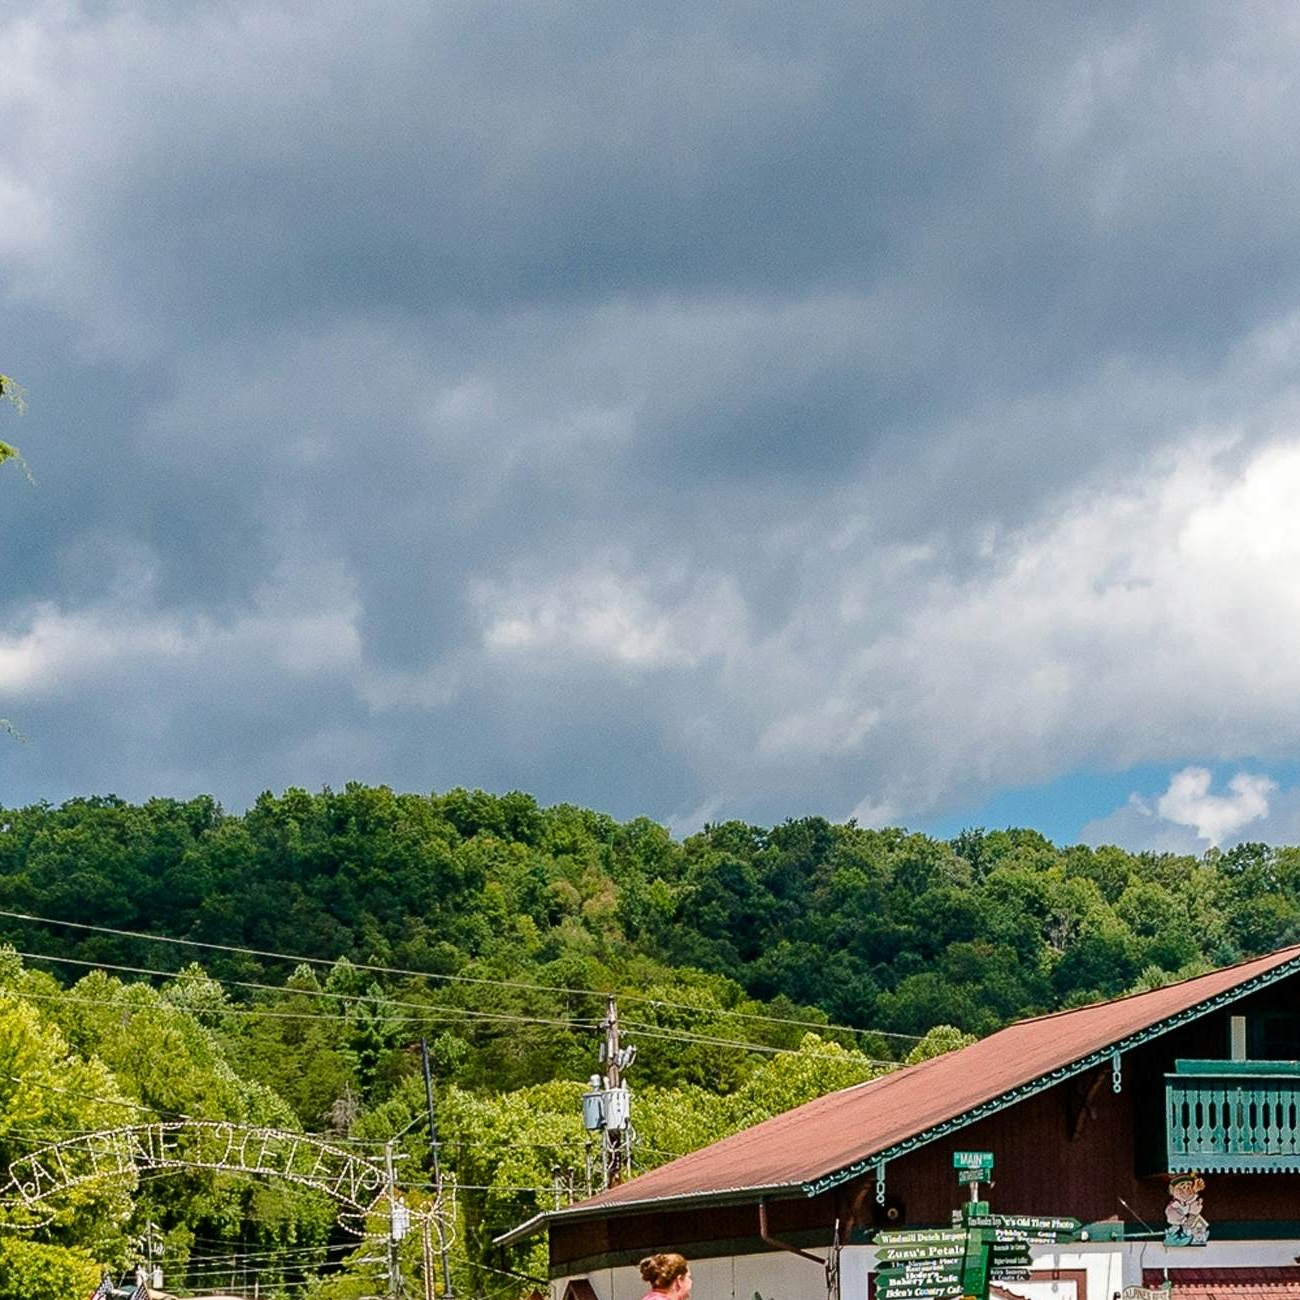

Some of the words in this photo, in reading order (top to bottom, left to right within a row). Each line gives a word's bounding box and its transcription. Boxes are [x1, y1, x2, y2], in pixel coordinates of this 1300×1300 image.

[960, 1152, 982, 1165] MAIN
[1016, 1218, 1031, 1227] Old
[1052, 1219, 1075, 1229] Photo
[881, 1233, 916, 1243] Windmill
[917, 1233, 941, 1242] Dutch
[941, 1232, 971, 1242] Imports
[887, 1247, 926, 1259] Zuzu's
[928, 1245, 966, 1257] Petals
[889, 1277, 925, 1287] Bakery
[914, 1287, 945, 1297] Country
